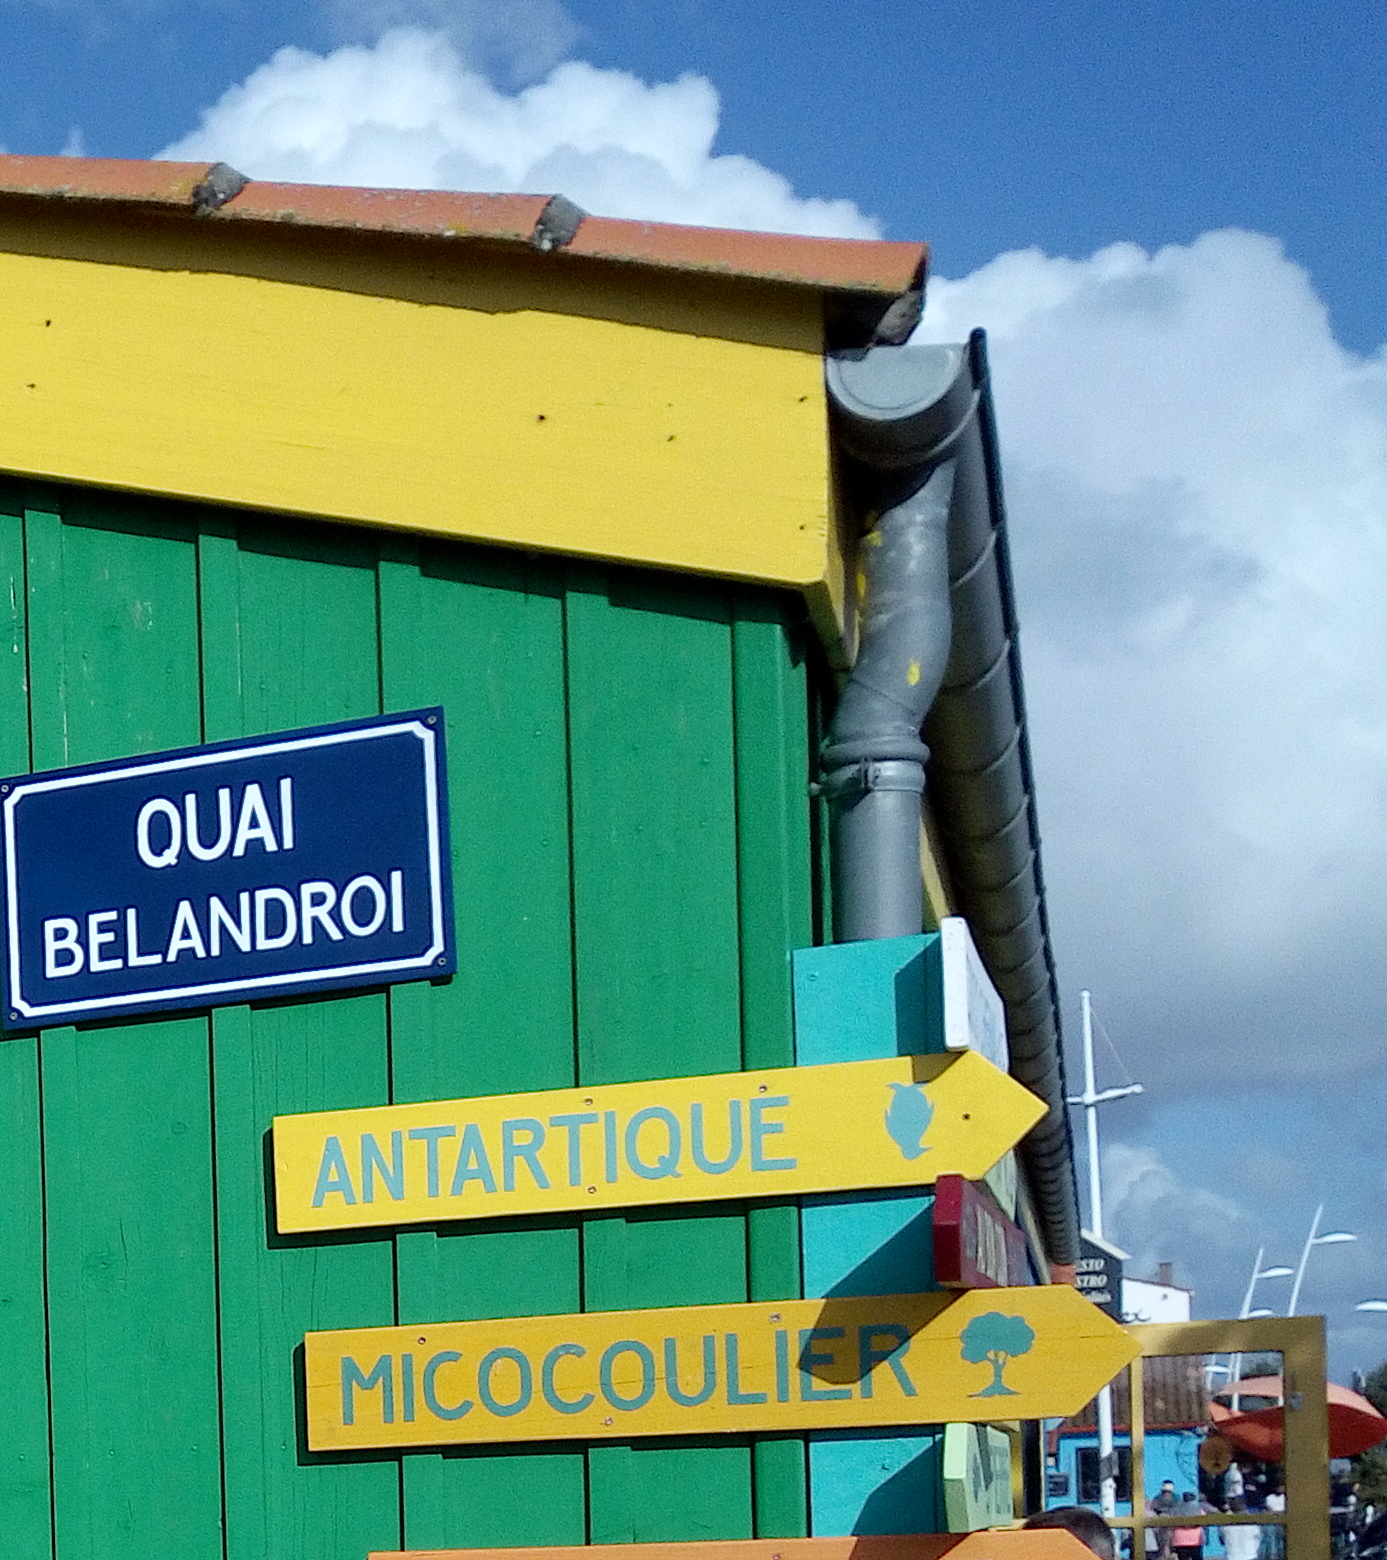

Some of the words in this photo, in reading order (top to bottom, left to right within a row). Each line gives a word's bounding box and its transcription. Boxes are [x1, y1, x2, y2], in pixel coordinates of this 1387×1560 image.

[137, 776, 294, 868] QUAI
[43, 870, 406, 979] BELANDROI
[310, 1096, 797, 1209] ANTARTIQUE
[1075, 1274, 1108, 1289] STRO
[1076, 1258, 1105, 1273] STO
[339, 1324, 919, 1426] MICOCOULIER
